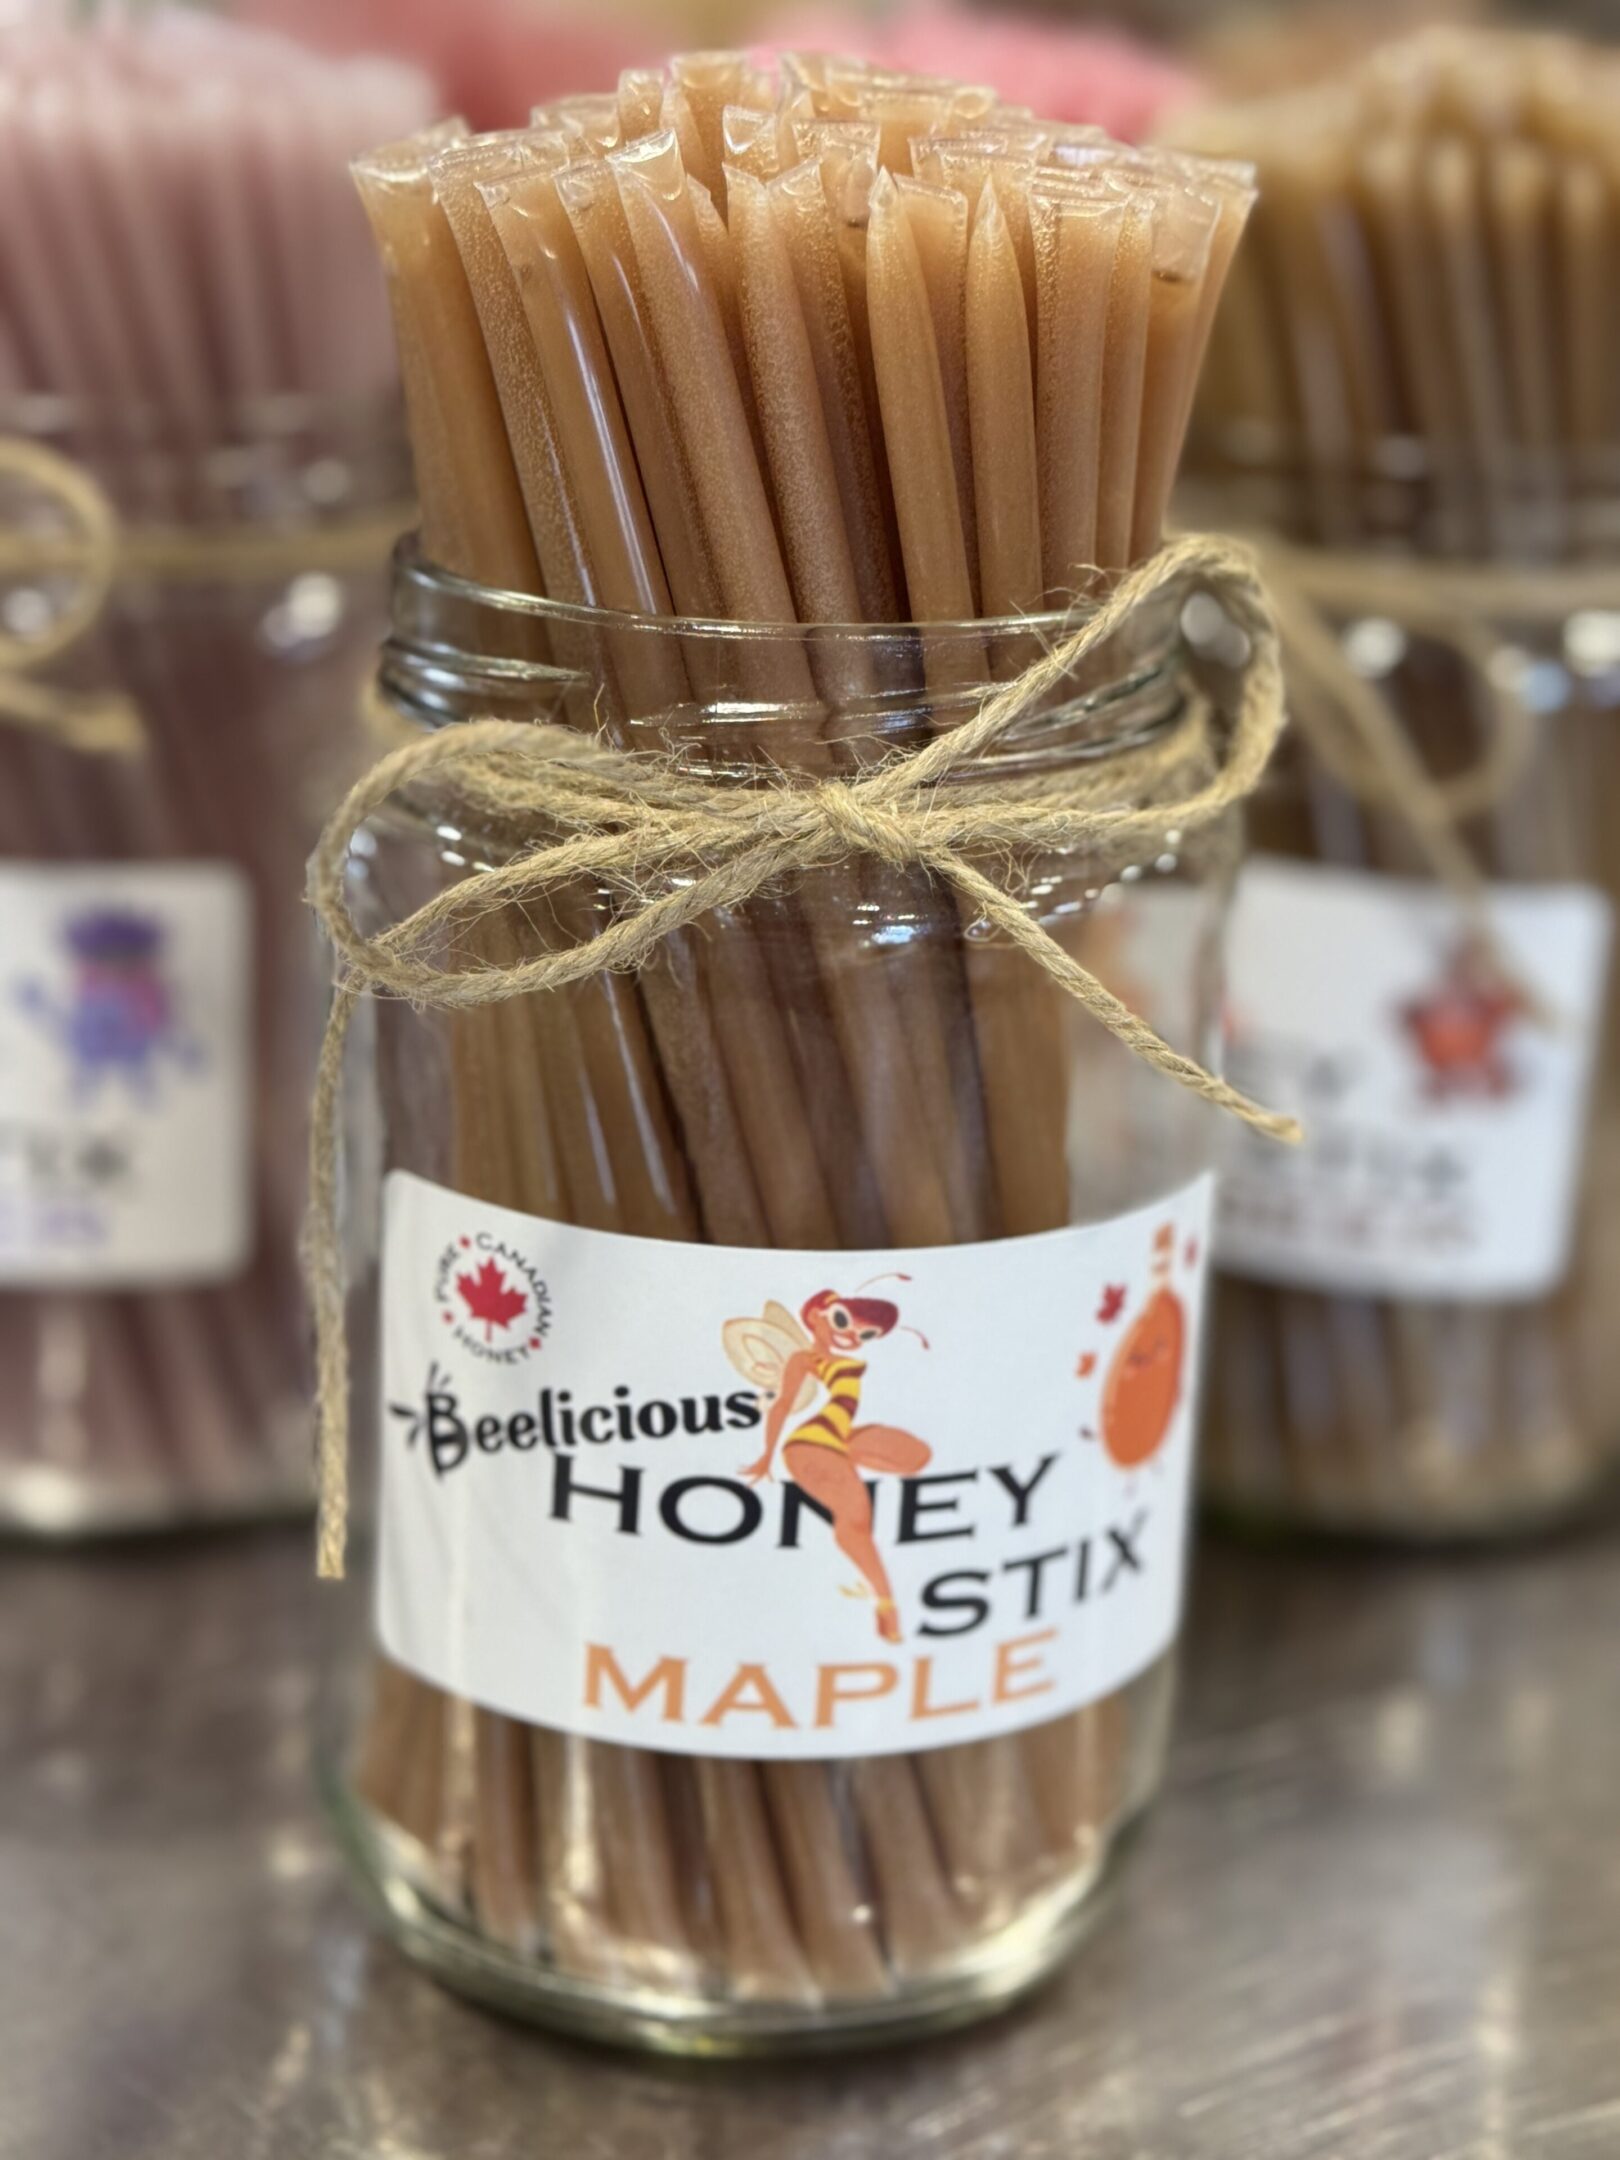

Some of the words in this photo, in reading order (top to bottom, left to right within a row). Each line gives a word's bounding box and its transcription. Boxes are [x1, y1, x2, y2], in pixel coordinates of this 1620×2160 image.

[475, 1231, 552, 1337] CANADIAN
[453, 1325, 530, 1365] HONEY
[424, 1385, 763, 1481] Beelicious
[549, 1451, 1061, 1549] HONEY
[915, 1508, 1148, 1639] STIX
[582, 1627, 1059, 1730] MAPLE
